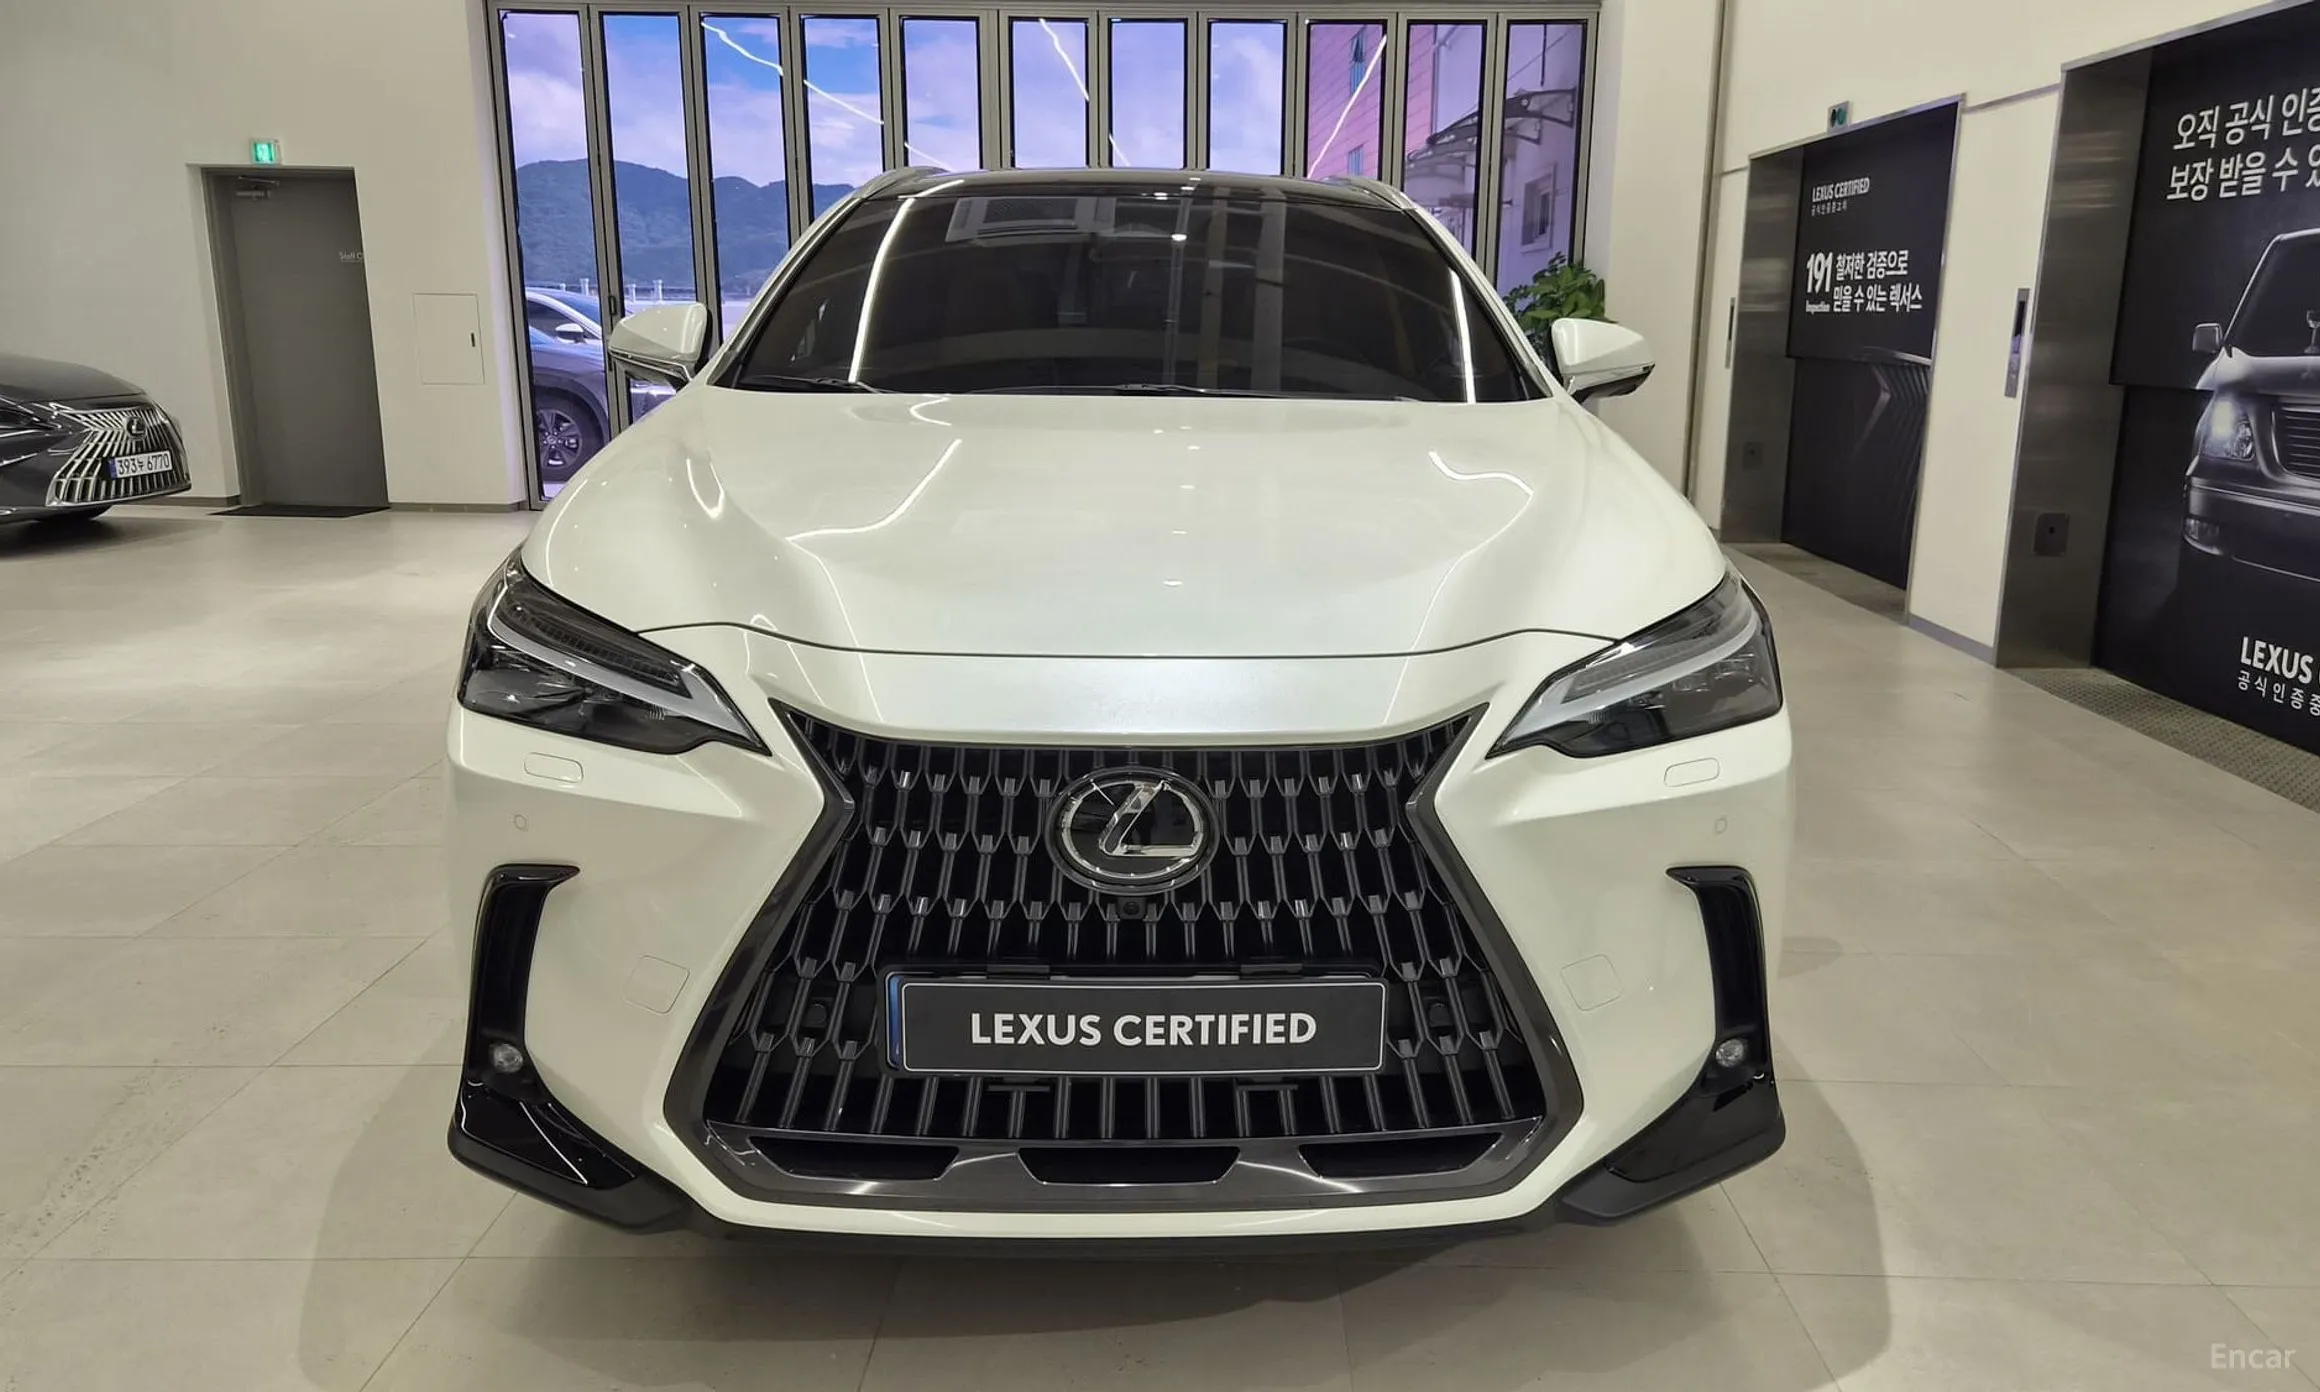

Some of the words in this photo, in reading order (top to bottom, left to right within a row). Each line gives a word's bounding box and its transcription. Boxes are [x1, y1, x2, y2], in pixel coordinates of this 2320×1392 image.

[2173, 105, 2219, 150] 오직
[2225, 95, 2274, 145] 공식
[1812, 184, 1833, 202] LEXUS
[1834, 177, 1869, 198] CERTIFIED
[2166, 158, 2214, 201] 보장
[2219, 151, 2266, 198] 받을
[2272, 147, 2298, 192] 수
[1806, 252, 1833, 293] 191
[1836, 251, 1865, 281] 철저한
[1867, 250, 1908, 279] 검증으로
[1833, 285, 1852, 312] 믿을
[1853, 285, 1864, 312] 수
[1866, 284, 1887, 312] 있는
[1889, 282, 1922, 312] 렉서스
[117, 458, 143, 475] 393누
[147, 453, 169, 471] 6770
[2240, 635, 2314, 684] LEXUS
[971, 1013, 1101, 1045] LEXUS
[1113, 1013, 1317, 1046] CERTIFIED
